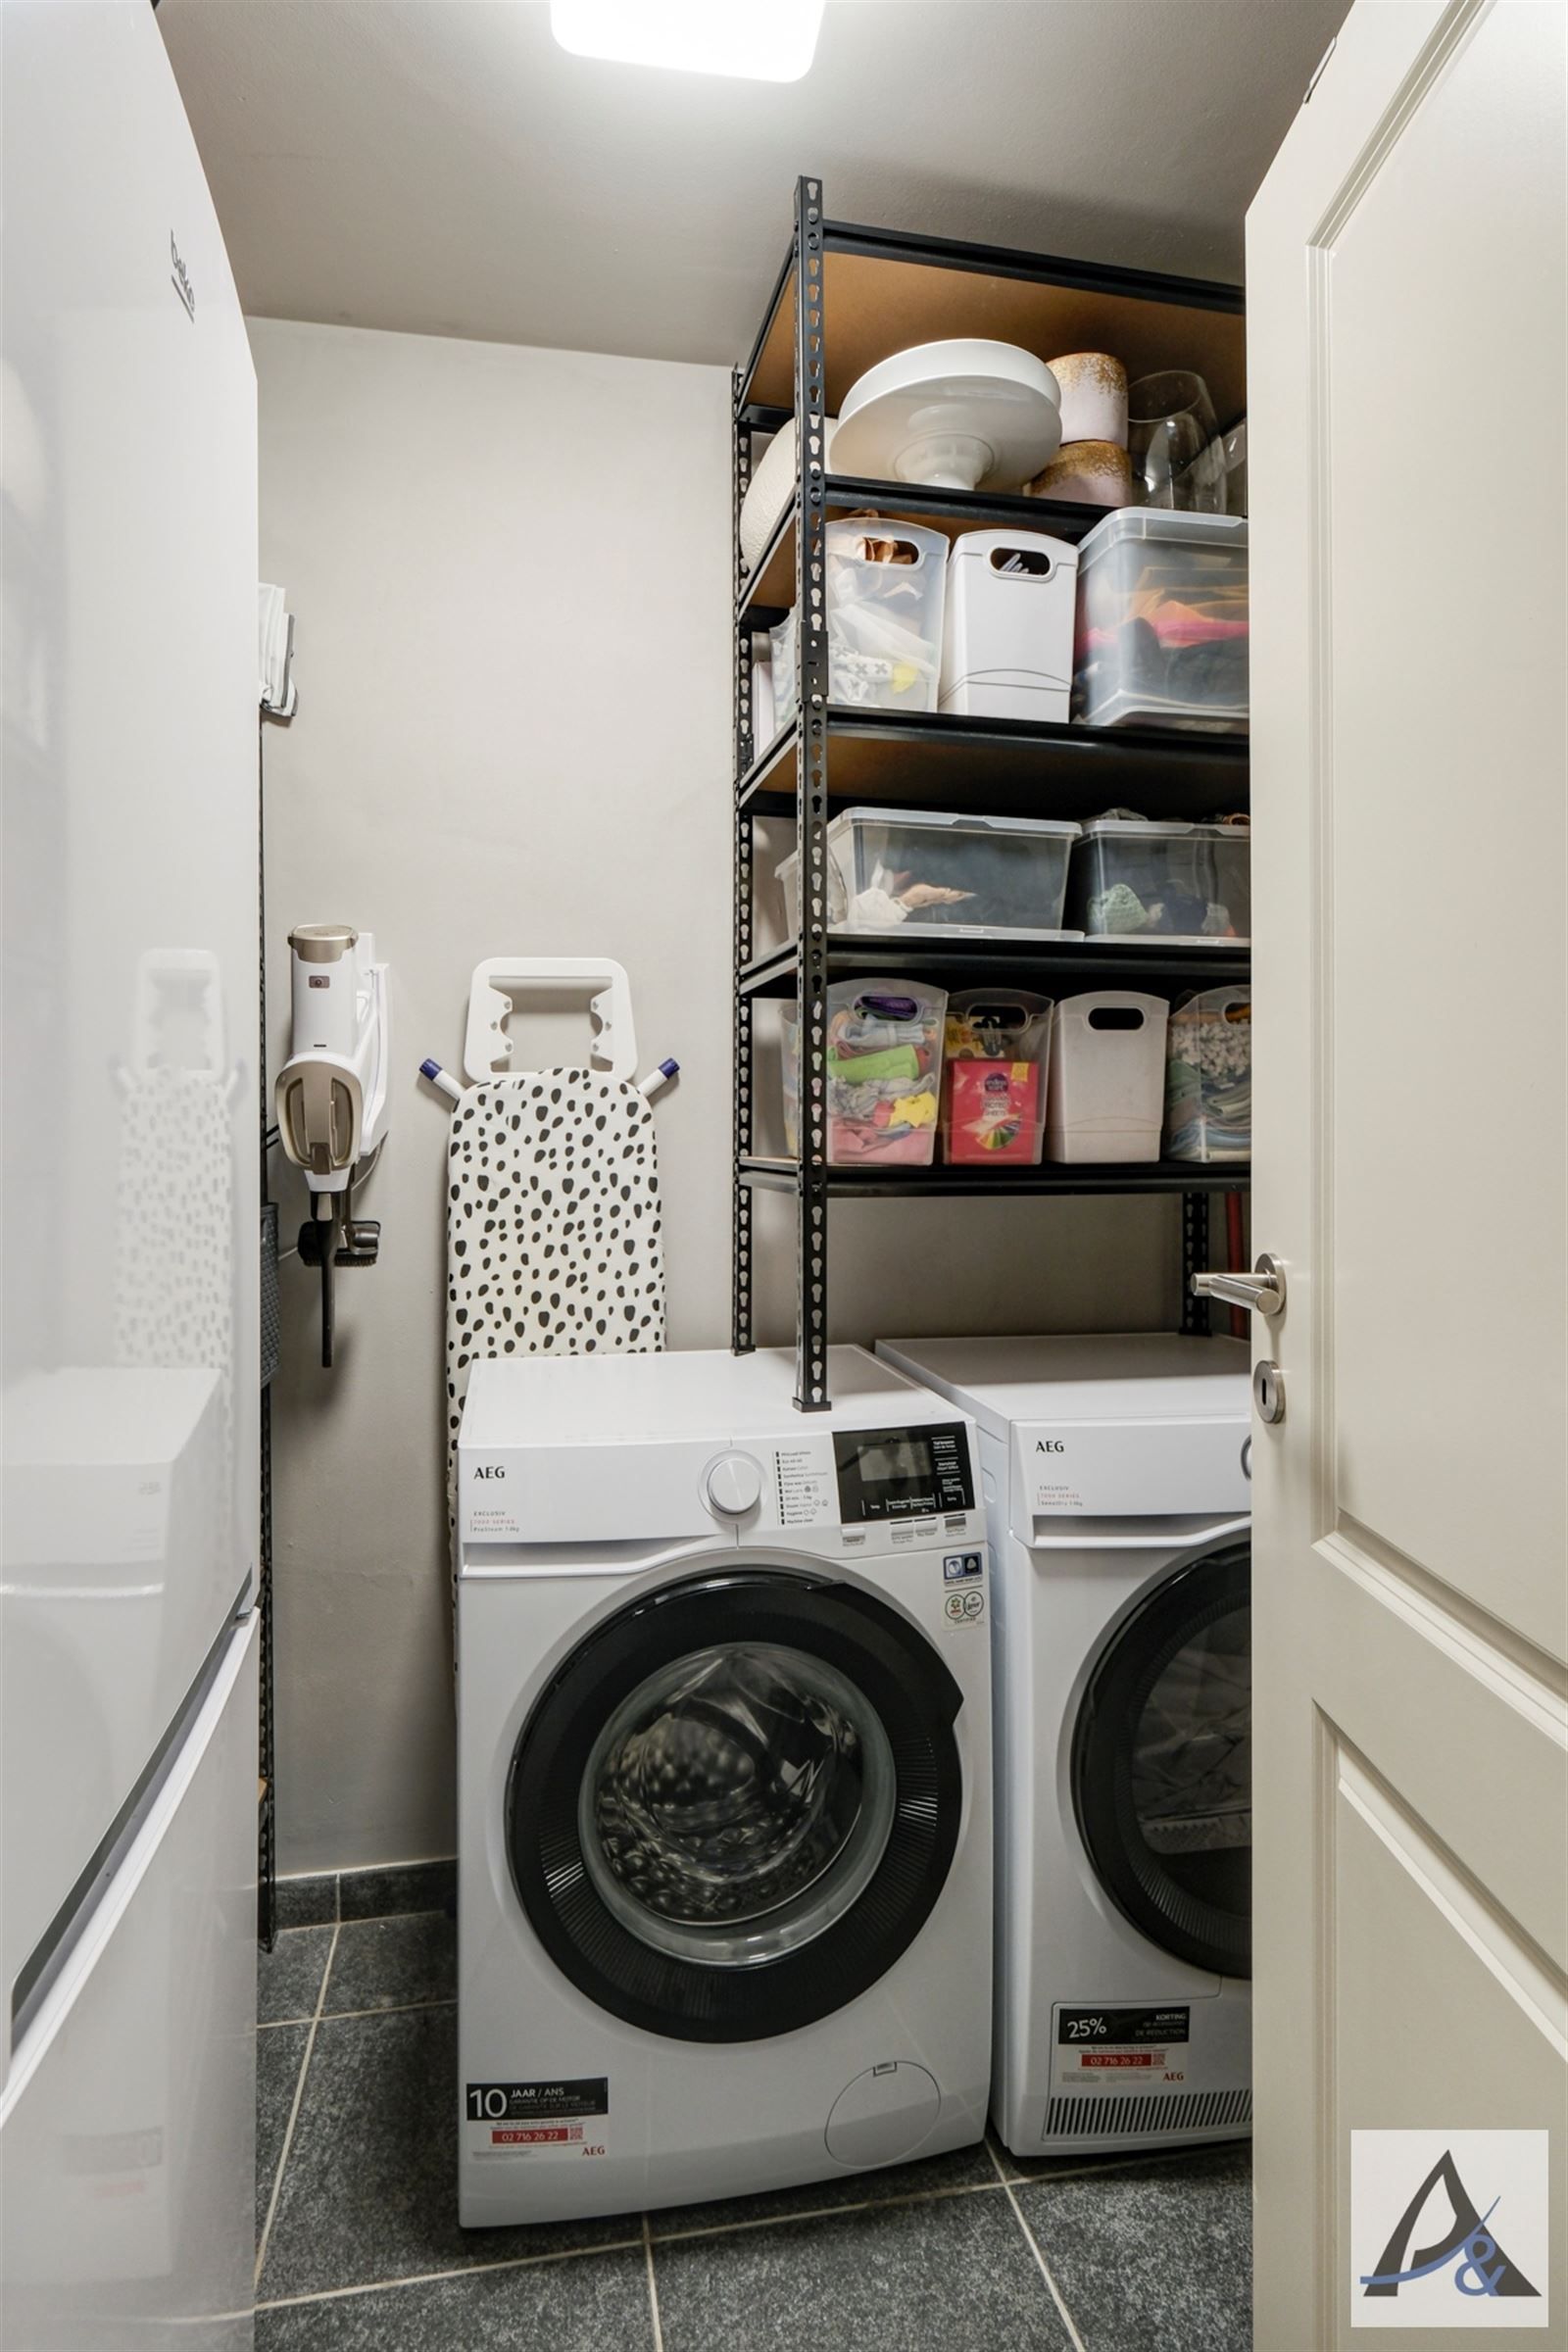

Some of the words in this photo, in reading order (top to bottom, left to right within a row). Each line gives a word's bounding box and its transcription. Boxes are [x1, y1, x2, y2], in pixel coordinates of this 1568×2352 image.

[1036, 1441, 1064, 1452] AEG
[473, 1466, 506, 1480] AEG
[1067, 2017, 1107, 2038] 25%
[1162, 2071, 1184, 2082] AEG
[511, 2088, 536, 2097] JAAR
[544, 2087, 564, 2096] ANS
[469, 2088, 508, 2118] 10
[502, 2132, 514, 2141] 02
[516, 2132, 531, 2140] 716
[534, 2131, 545, 2140] 26
[548, 2131, 559, 2139] 22
[582, 2146, 605, 2156] AEG
